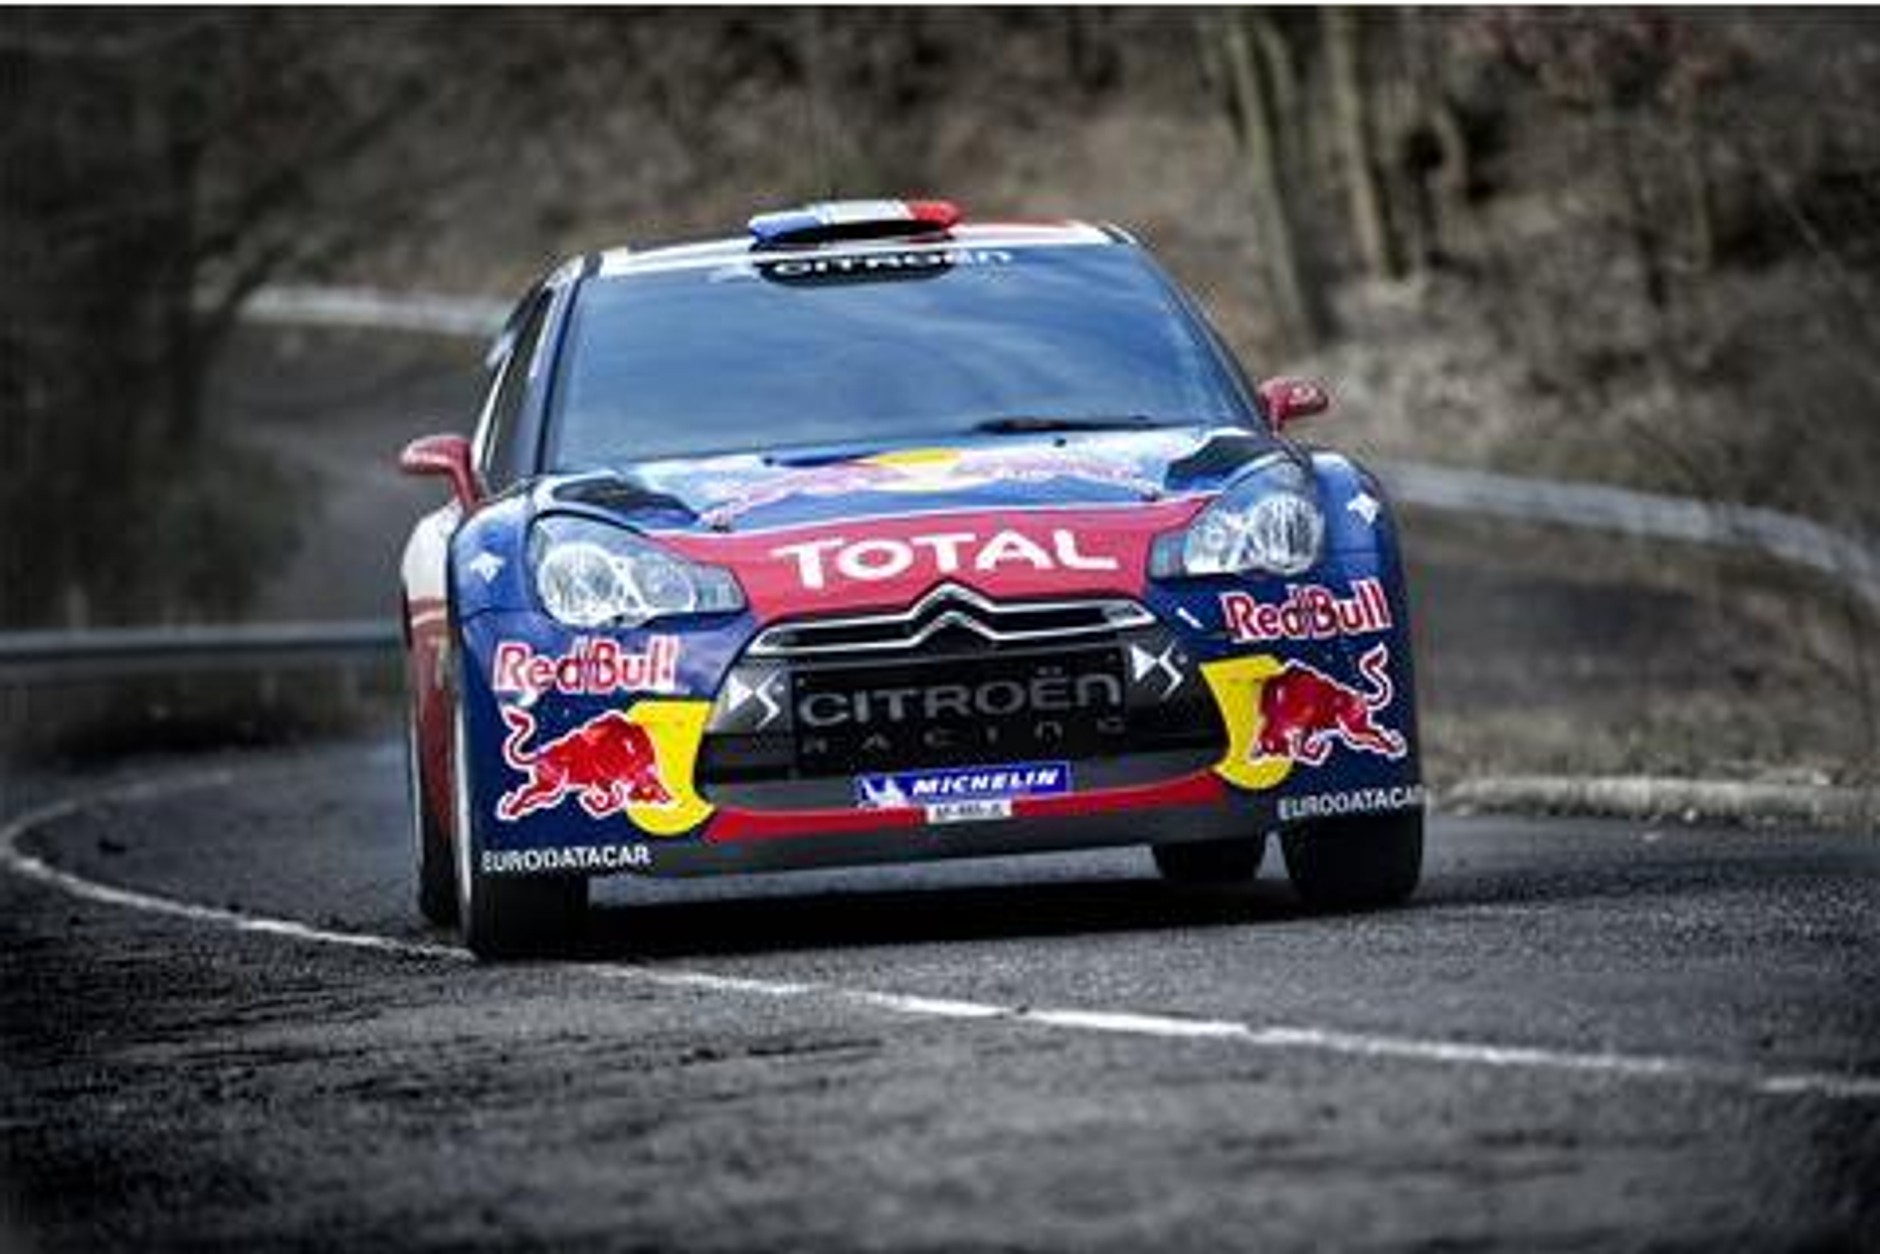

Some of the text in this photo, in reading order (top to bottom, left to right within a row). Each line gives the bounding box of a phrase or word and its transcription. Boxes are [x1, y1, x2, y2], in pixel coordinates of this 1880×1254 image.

[772, 529, 1119, 591] TOTAL
[912, 768, 1060, 796] MICHELIN
[482, 845, 651, 873] EURODATACAR
